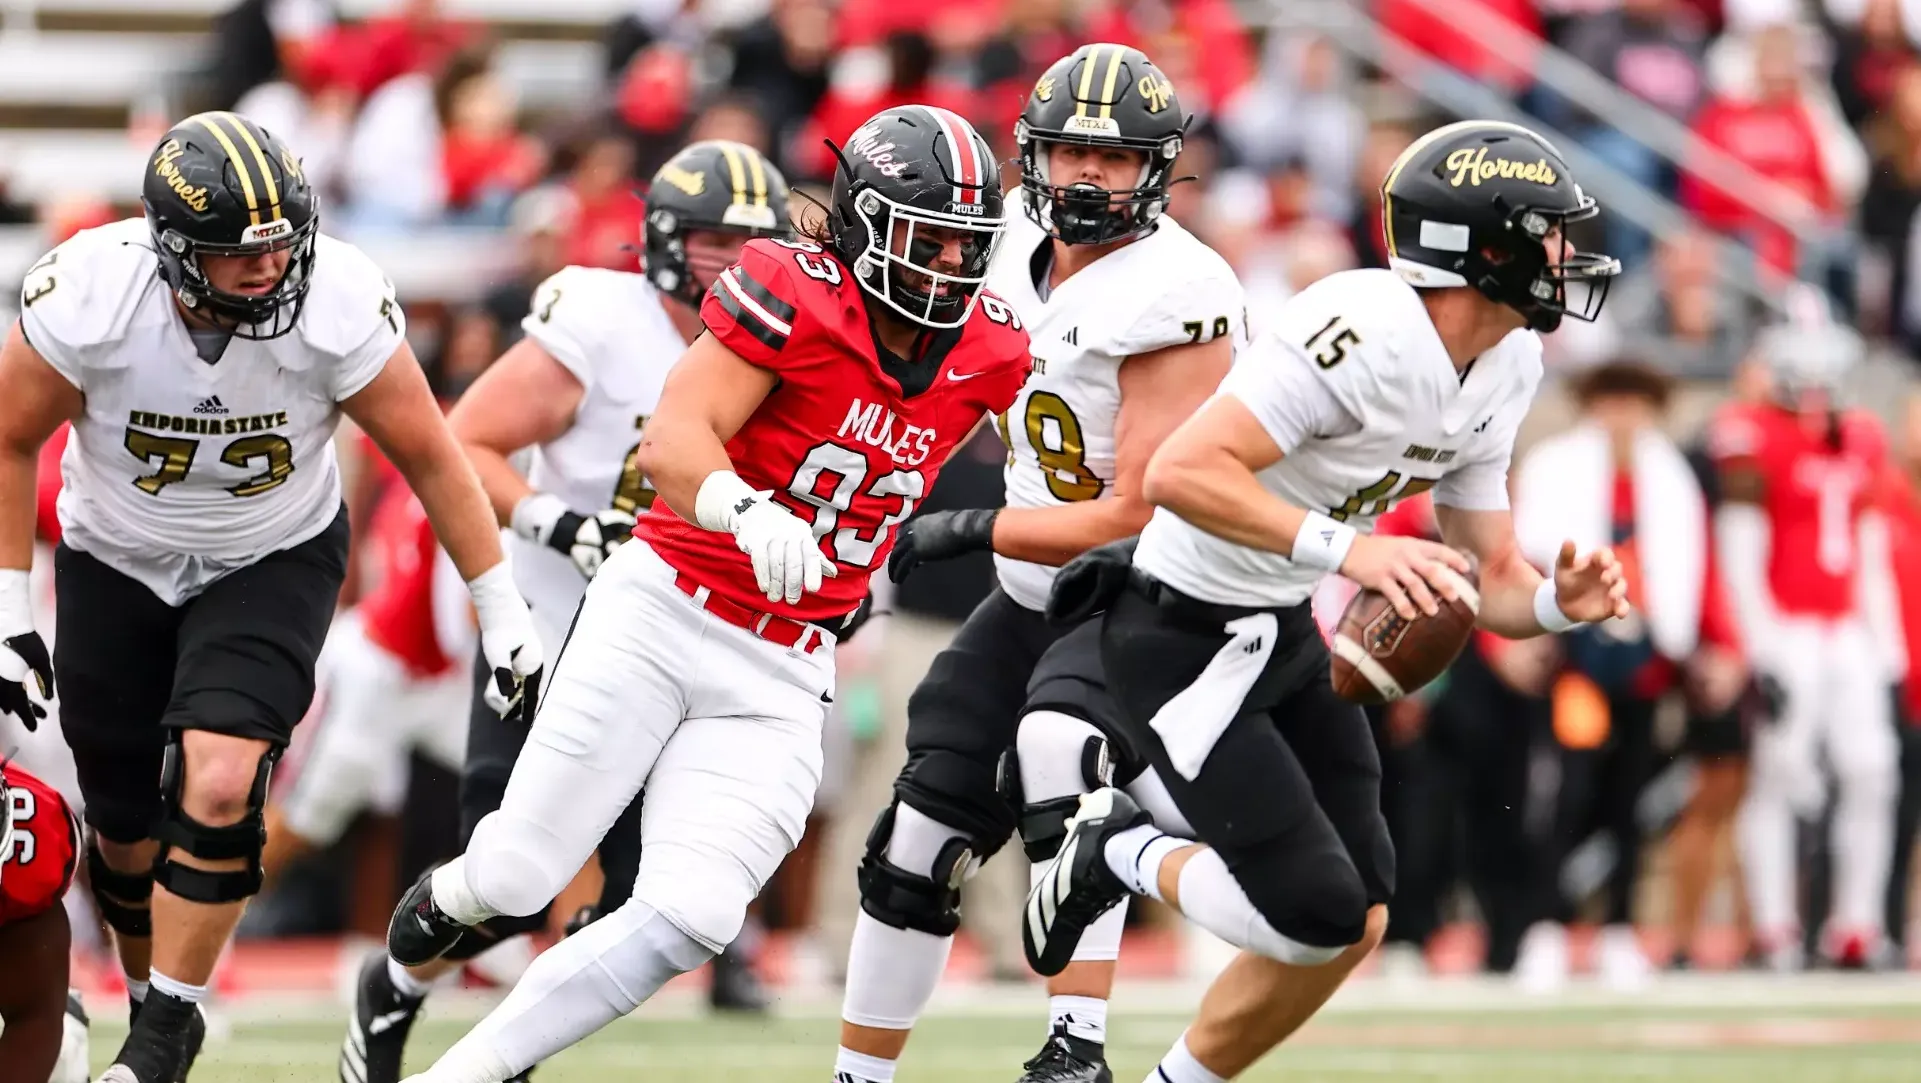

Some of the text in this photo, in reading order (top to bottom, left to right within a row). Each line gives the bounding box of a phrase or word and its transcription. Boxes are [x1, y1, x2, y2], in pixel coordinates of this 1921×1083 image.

[850, 123, 908, 177] Mules
[1075, 117, 1109, 130] MTXE
[154, 138, 208, 212] Hornets
[1446, 147, 1557, 187] Hornets
[252, 224, 285, 239] MTXE
[951, 203, 984, 216] MULES
[1304, 315, 1361, 370] 15
[193, 407, 230, 415] adidas
[837, 398, 937, 466] MULES
[123, 425, 295, 497] 73
[771, 440, 925, 568] 93
